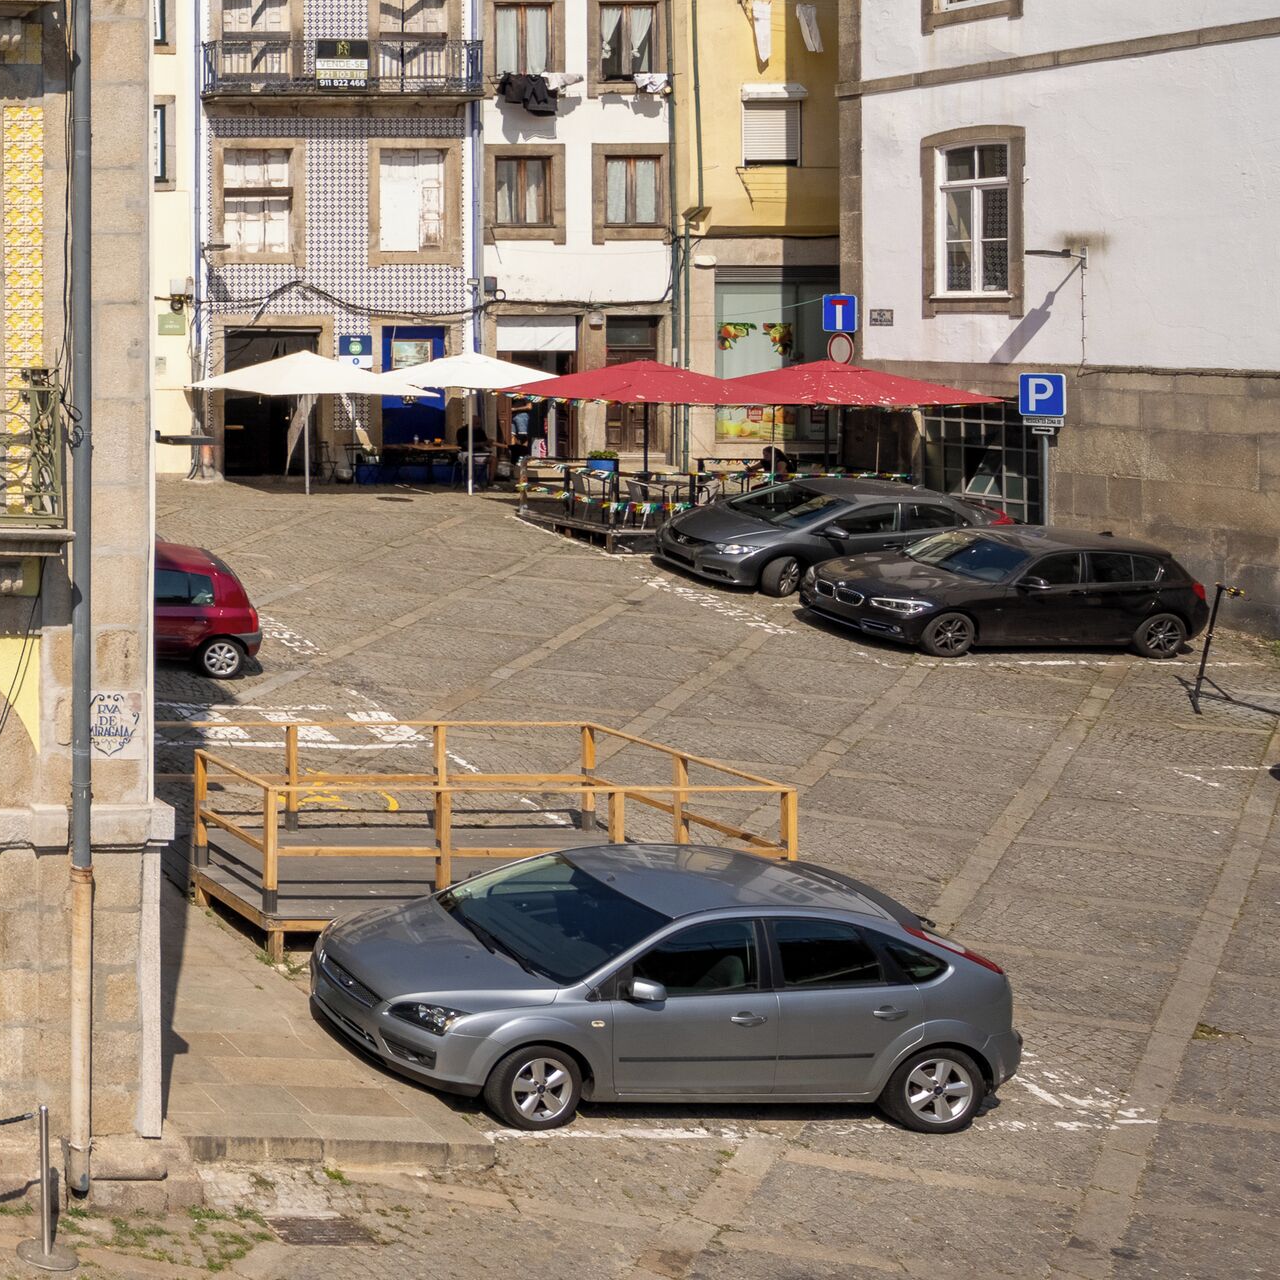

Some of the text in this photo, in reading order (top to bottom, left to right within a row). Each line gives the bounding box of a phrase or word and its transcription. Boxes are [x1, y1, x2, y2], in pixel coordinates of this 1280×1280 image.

[319, 60, 365, 68] VENDE-SE
[1028, 377, 1054, 412] P
[99, 715, 118, 726] DE
